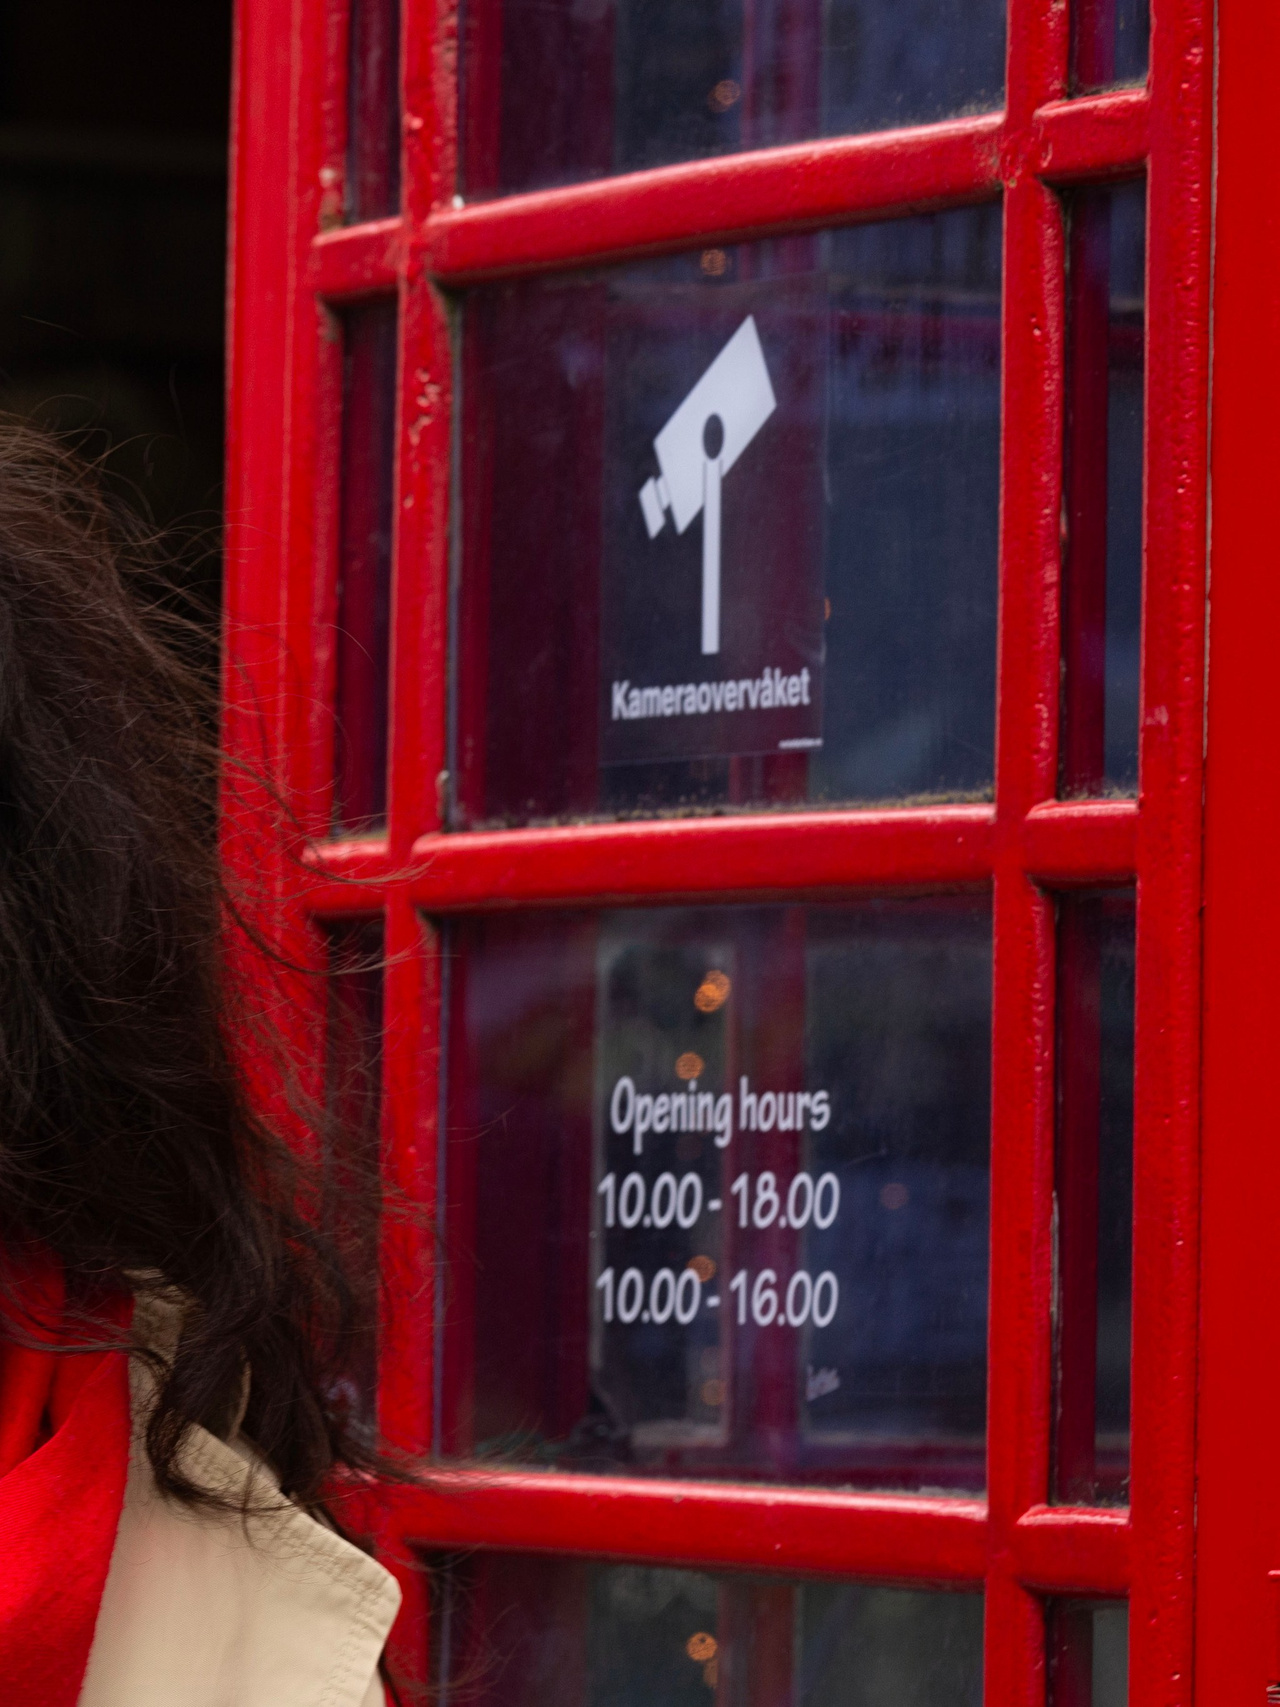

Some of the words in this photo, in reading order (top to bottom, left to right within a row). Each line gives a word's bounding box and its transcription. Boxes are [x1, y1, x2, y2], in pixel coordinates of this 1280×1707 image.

[611, 666, 810, 721] Kameraovervåket
[610, 1075, 733, 1156] Opening
[740, 1075, 832, 1132] hours
[596, 1171, 703, 1230] 10.00
[731, 1171, 841, 1230] 18.00
[595, 1266, 702, 1325] 10.00
[729, 1268, 839, 1328] 16.00
